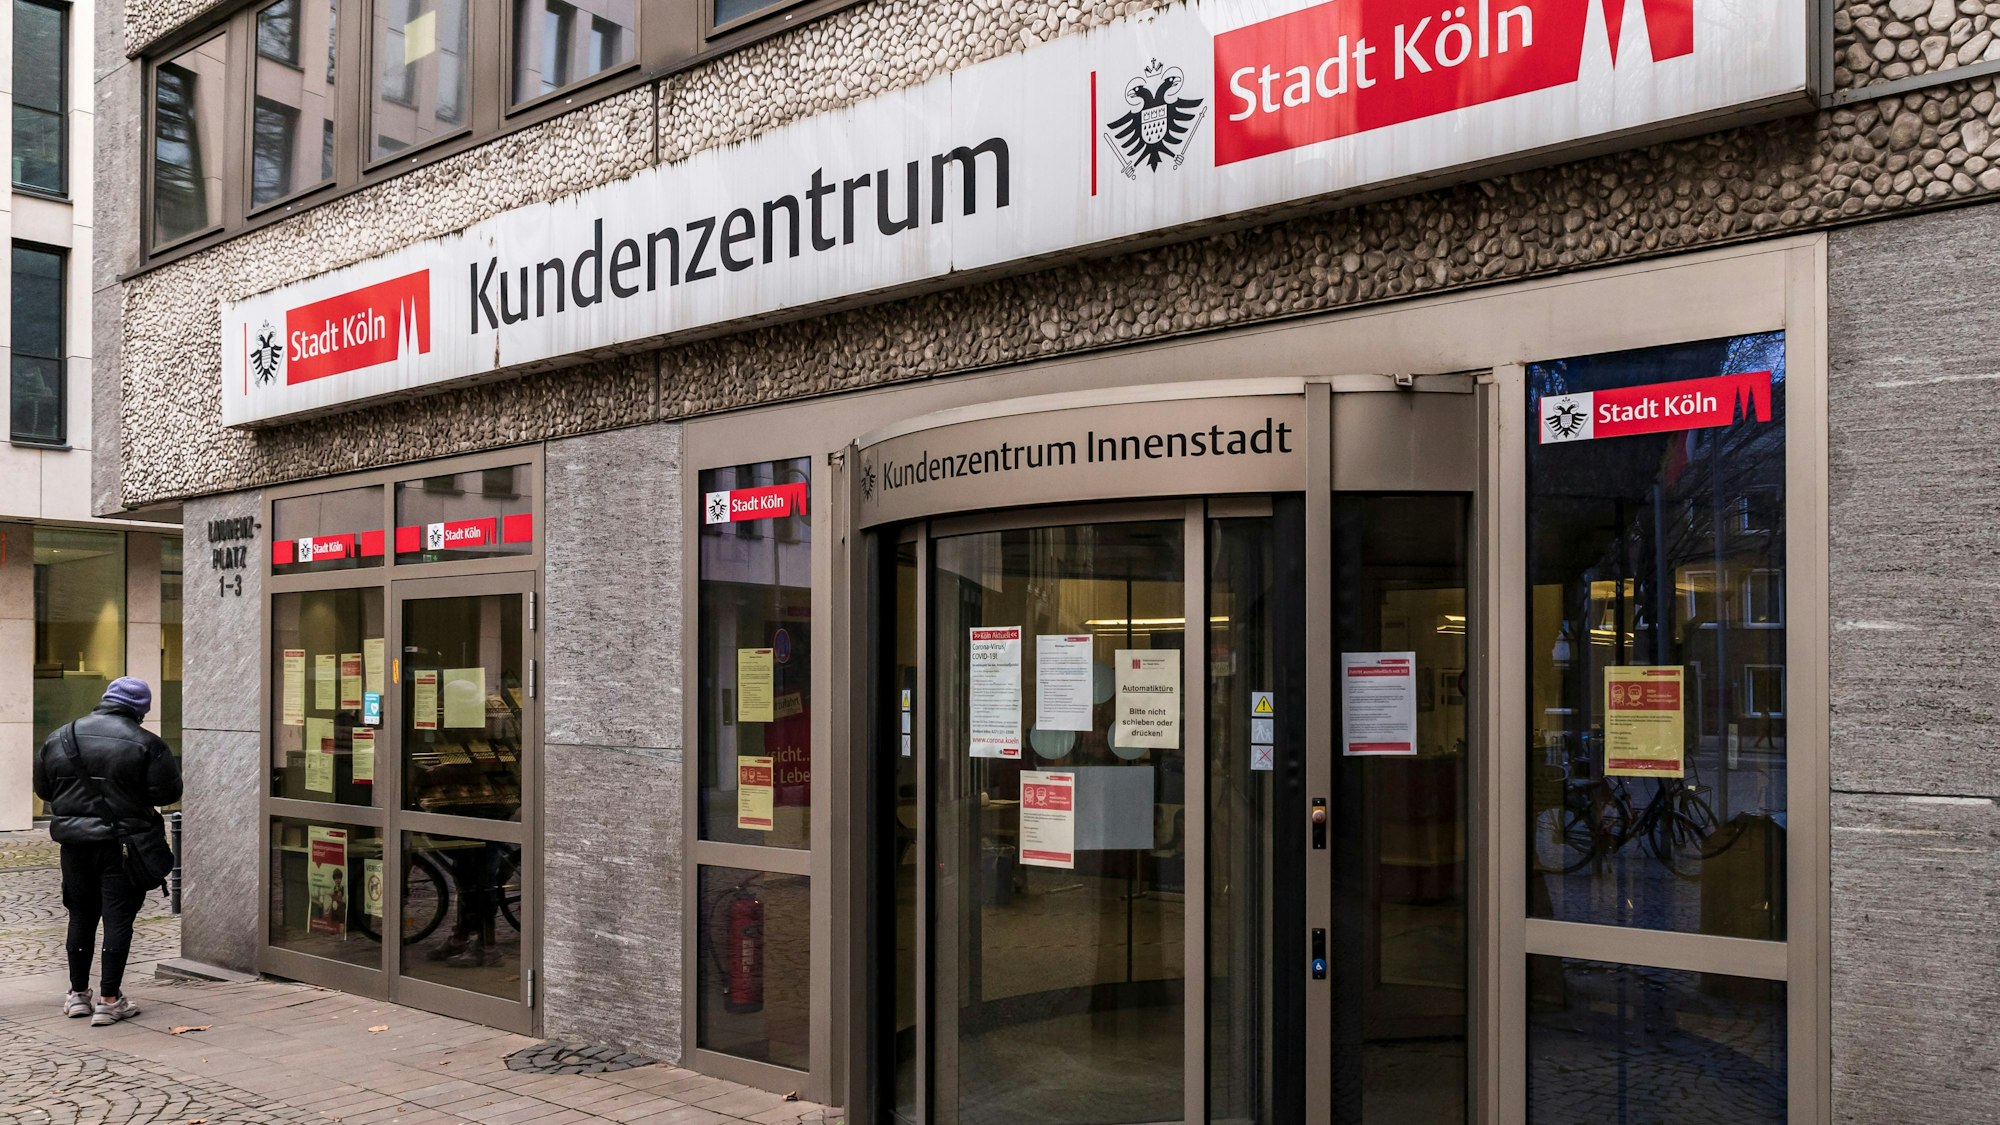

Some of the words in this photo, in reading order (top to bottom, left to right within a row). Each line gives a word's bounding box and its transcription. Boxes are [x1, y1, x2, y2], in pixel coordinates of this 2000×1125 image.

[1229, 35, 1376, 121] Stadt
[1395, 0, 1533, 80] Köln
[471, 137, 1010, 334] Kundenzentrum
[291, 320, 339, 361] Stadt
[343, 307, 386, 349] Köln
[1599, 397, 1659, 423] Stadt
[1665, 391, 1717, 416] Köln
[883, 439, 1077, 490] Kundenzentrum
[1088, 418, 1292, 463] Innenstadt
[732, 496, 758, 512] Stadt
[760, 494, 784, 509] Köln
[208, 515, 261, 542] LAURENZ-
[445, 528, 463, 540] Stadt
[464, 526, 481, 539] Köln
[213, 545, 247, 570] PLATZ
[313, 542, 329, 554] Stadt
[329, 541, 343, 552] Köln
[1122, 684, 1174, 693] Automatiktüre
[1131, 729, 1163, 737] drücken!
[1156, 719, 1173, 727] oder
